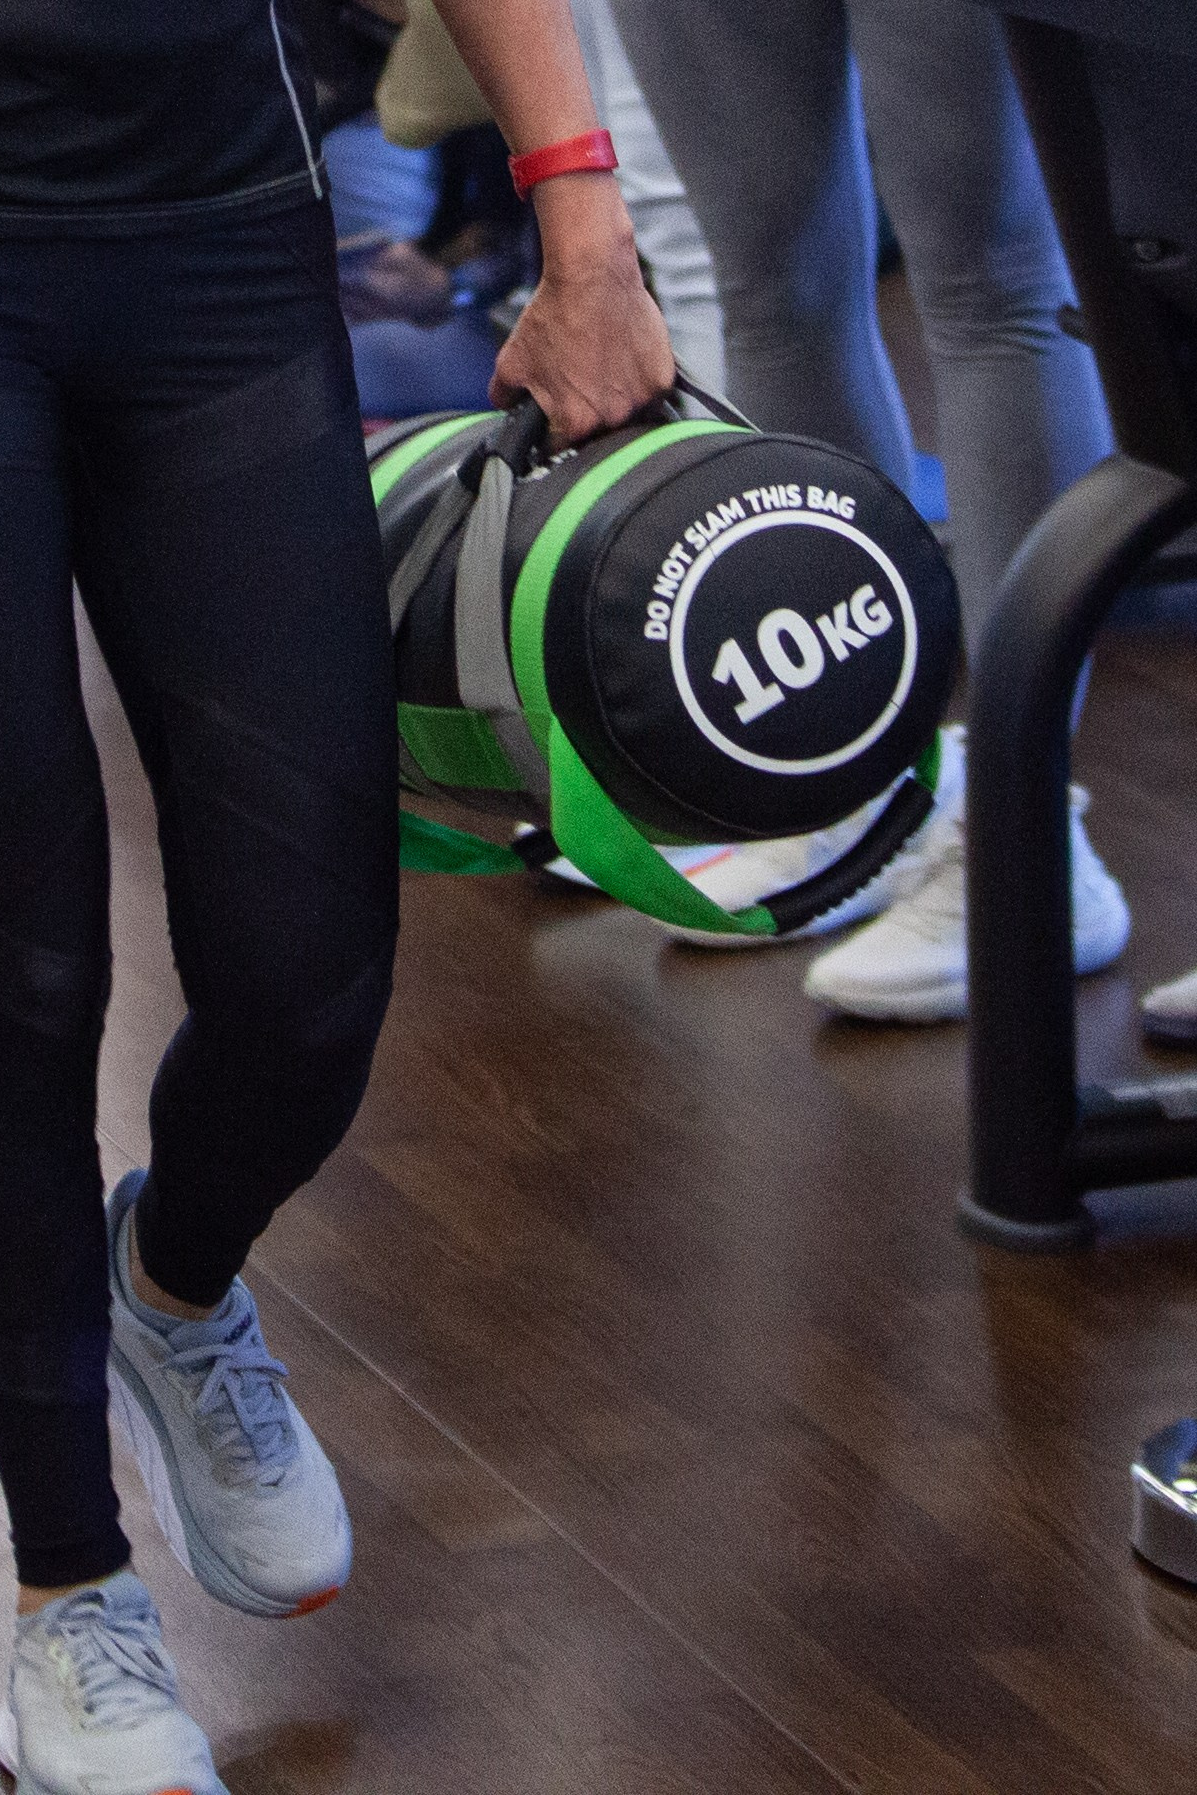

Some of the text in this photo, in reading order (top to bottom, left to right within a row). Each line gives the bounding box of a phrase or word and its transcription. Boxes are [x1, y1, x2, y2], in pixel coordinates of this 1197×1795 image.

[643, 483, 856, 641] DO NOT SLAM THIS BAG
